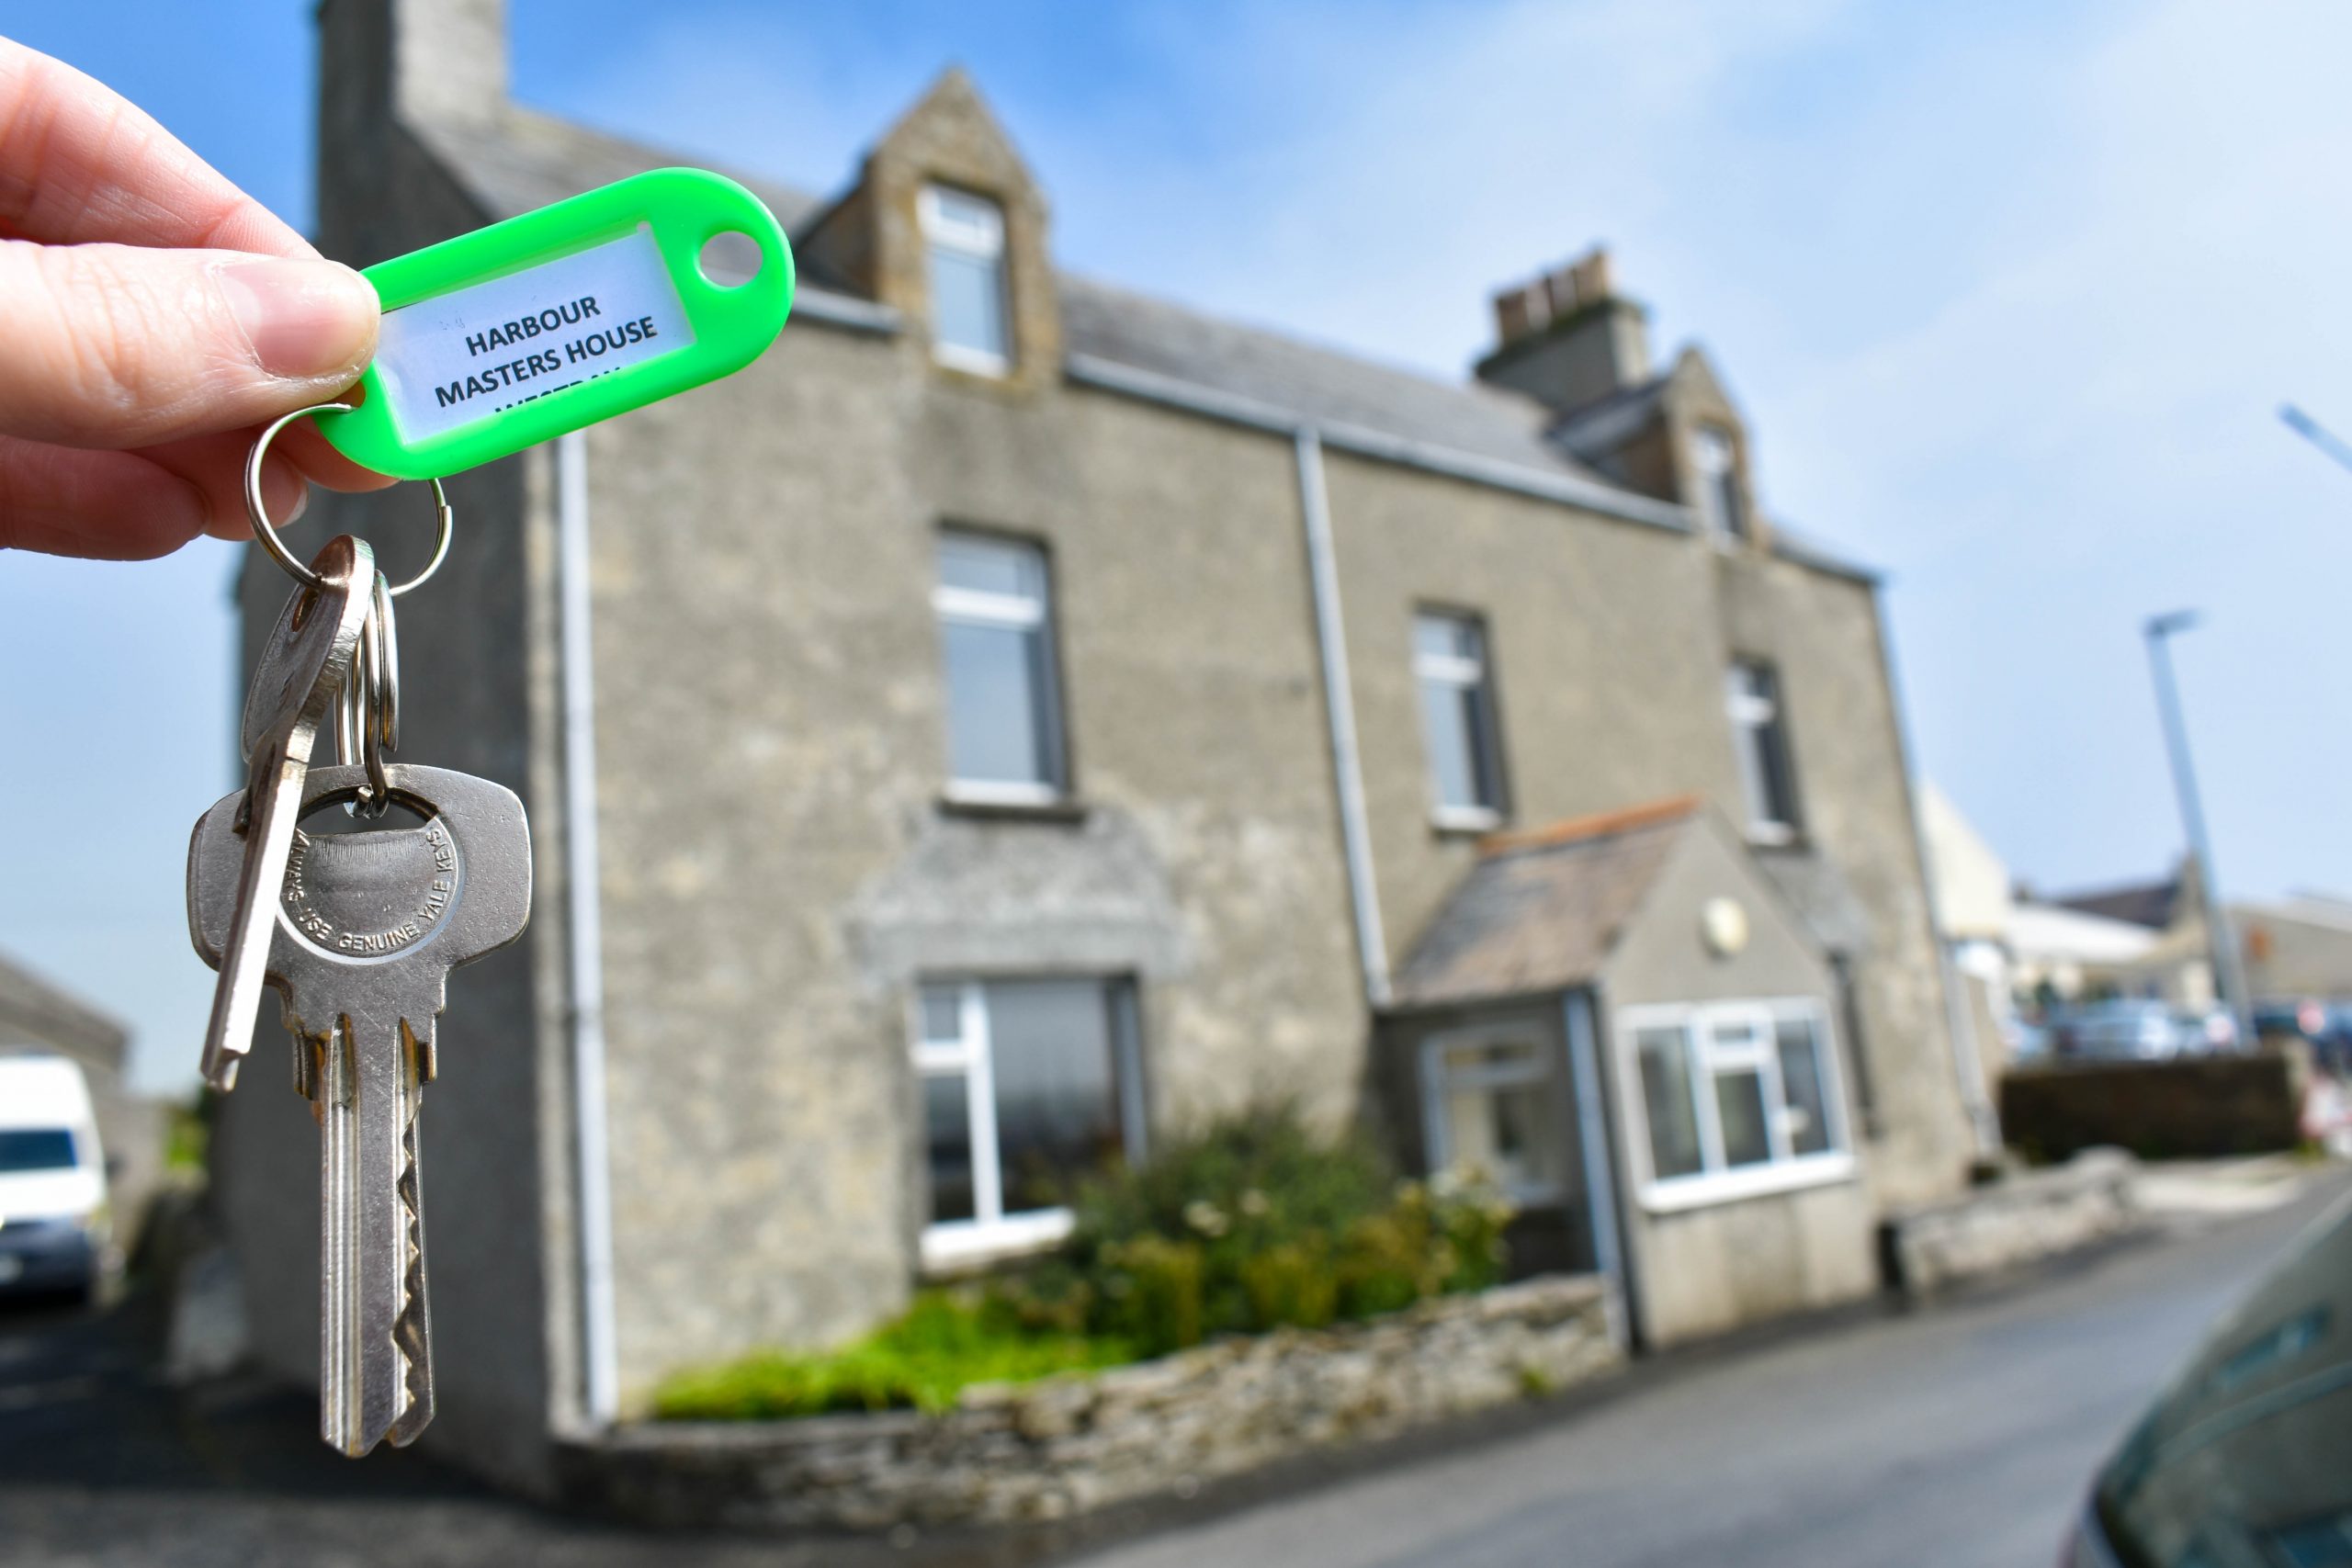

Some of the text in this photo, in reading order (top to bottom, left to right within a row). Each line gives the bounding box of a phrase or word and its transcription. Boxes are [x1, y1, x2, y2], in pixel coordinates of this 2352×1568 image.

[466, 296, 601, 356] HARBOUR
[435, 348, 561, 408] MASTERS
[565, 317, 658, 364] HOUSE
[426, 828, 454, 873] KEYS
[418, 880, 450, 921] YALE
[299, 908, 333, 940] USE
[338, 921, 421, 952] GENUINE
